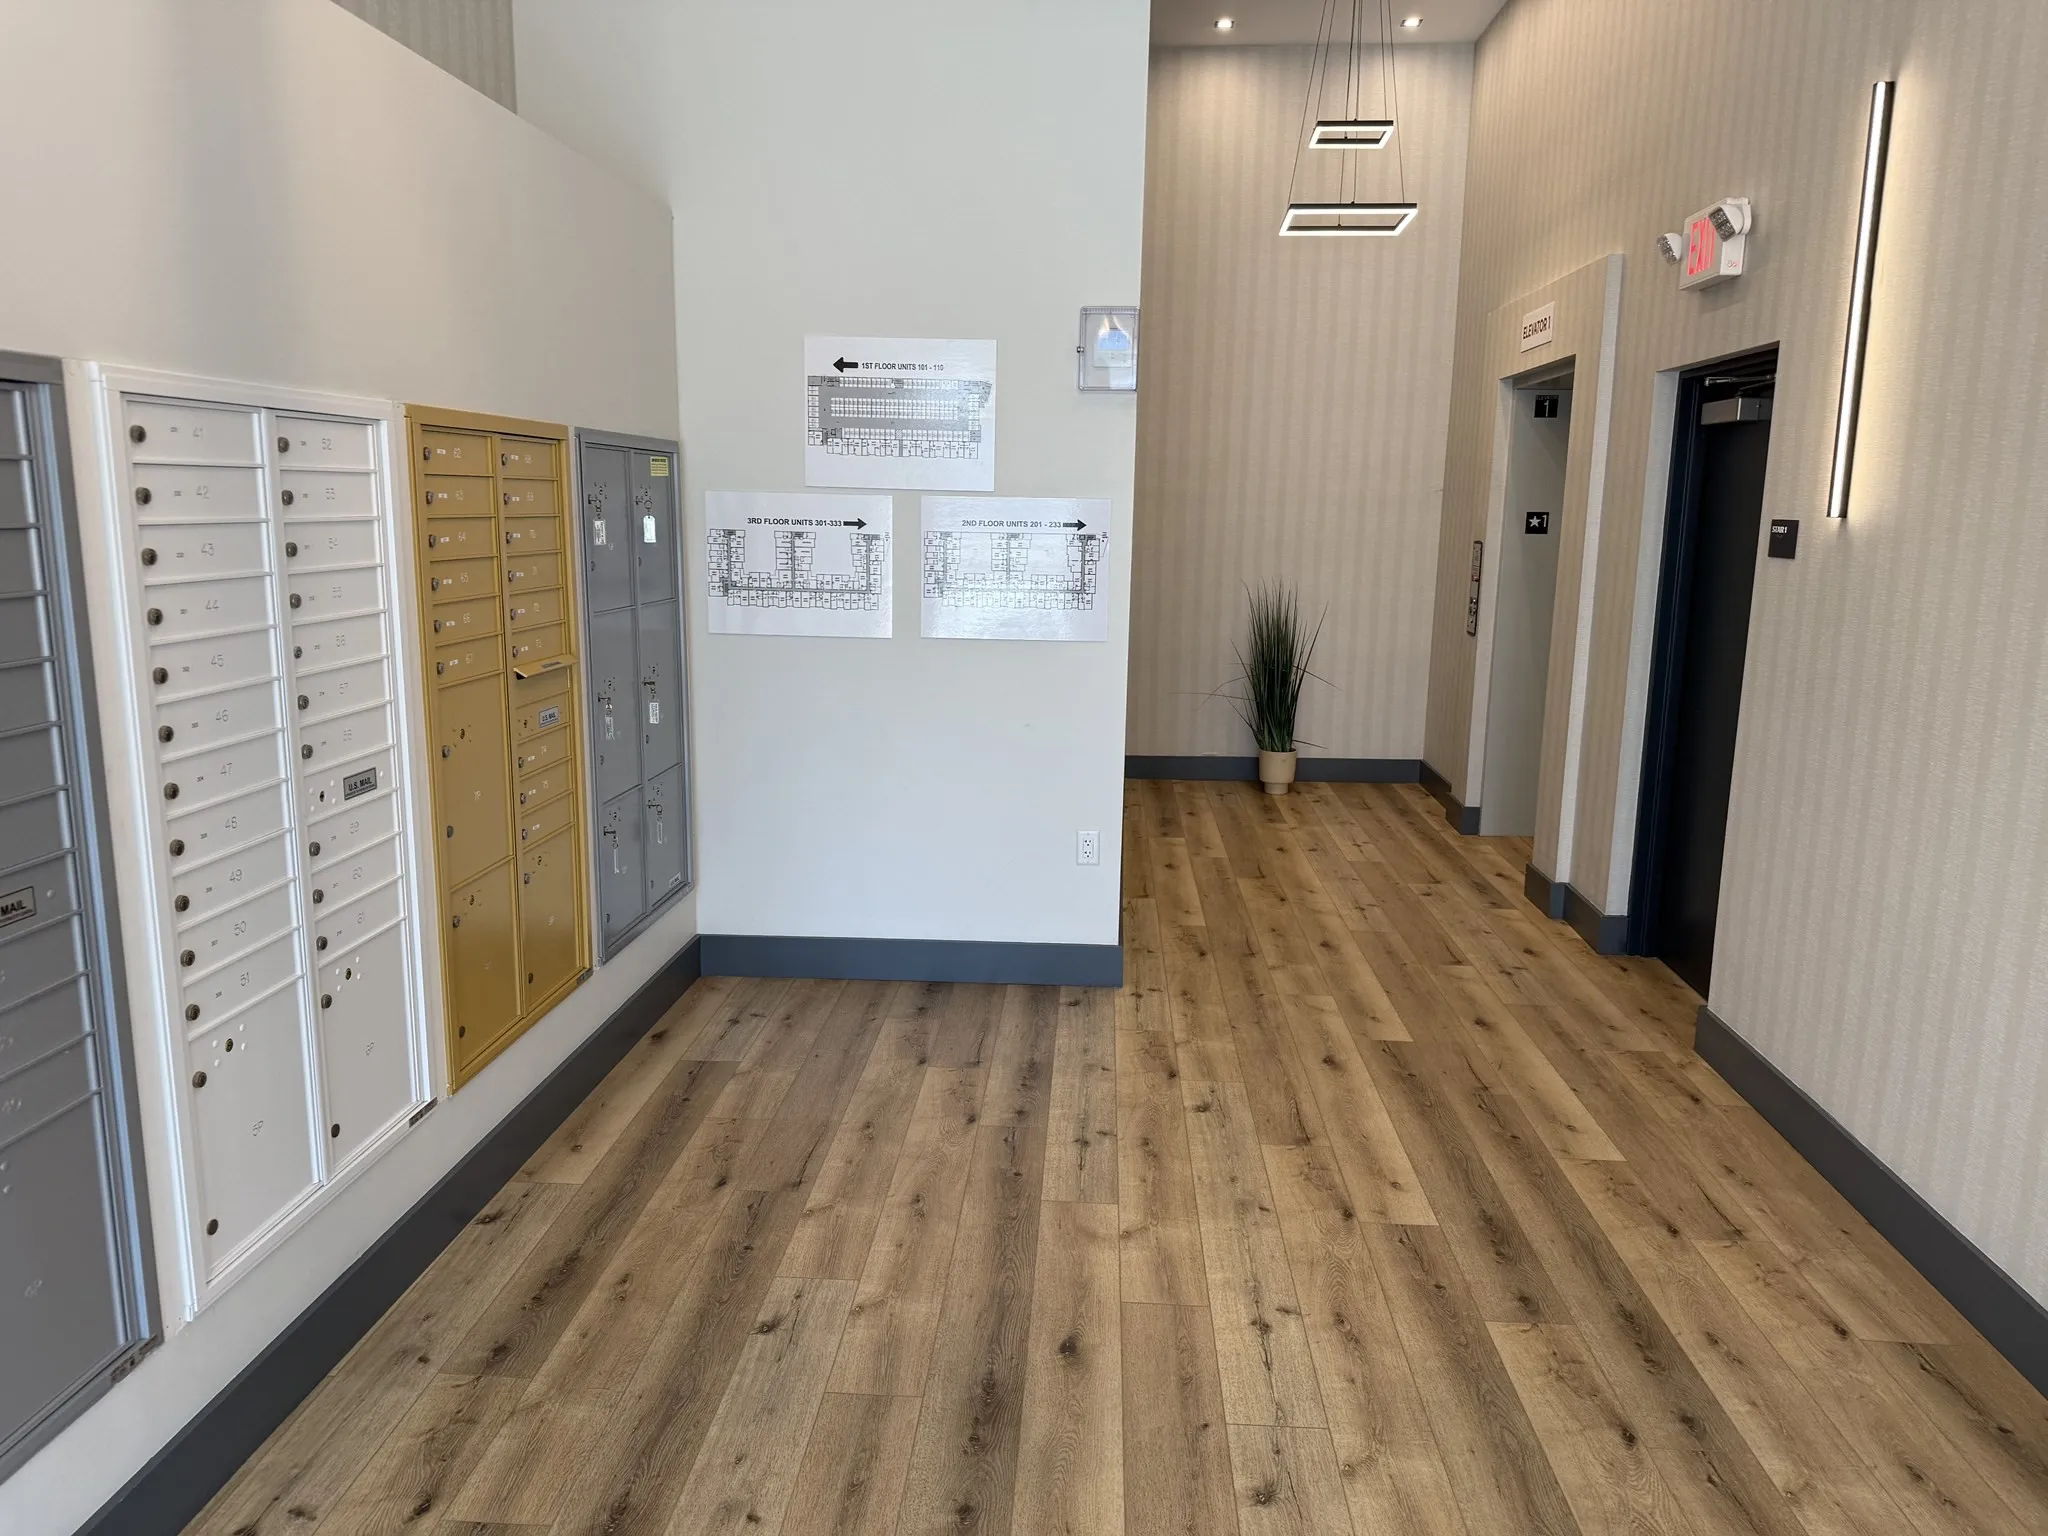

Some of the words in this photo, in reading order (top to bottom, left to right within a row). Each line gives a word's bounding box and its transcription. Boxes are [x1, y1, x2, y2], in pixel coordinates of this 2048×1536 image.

[1523, 317, 1547, 339] ELEVATOR
[861, 362, 873, 370] 1ST
[874, 362, 896, 370] FLOOR
[1544, 400, 1549, 418] 1
[195, 485, 210, 499] 42
[791, 518, 813, 526] UNITS
[815, 519, 842, 527] 301-333
[961, 519, 977, 527] 2ND
[1542, 514, 1547, 527] 1
[201, 542, 215, 557] 43
[211, 653, 224, 668] 45
[215, 709, 229, 722] 46
[219, 762, 233, 776] 47
[348, 781, 359, 792] U.S.
[359, 776, 373, 788] MAIL
[224, 815, 238, 830] 48
[229, 868, 243, 882] 49
[1, 899, 27, 918] MAIL
[234, 920, 247, 936] 50
[240, 971, 250, 987] 51
